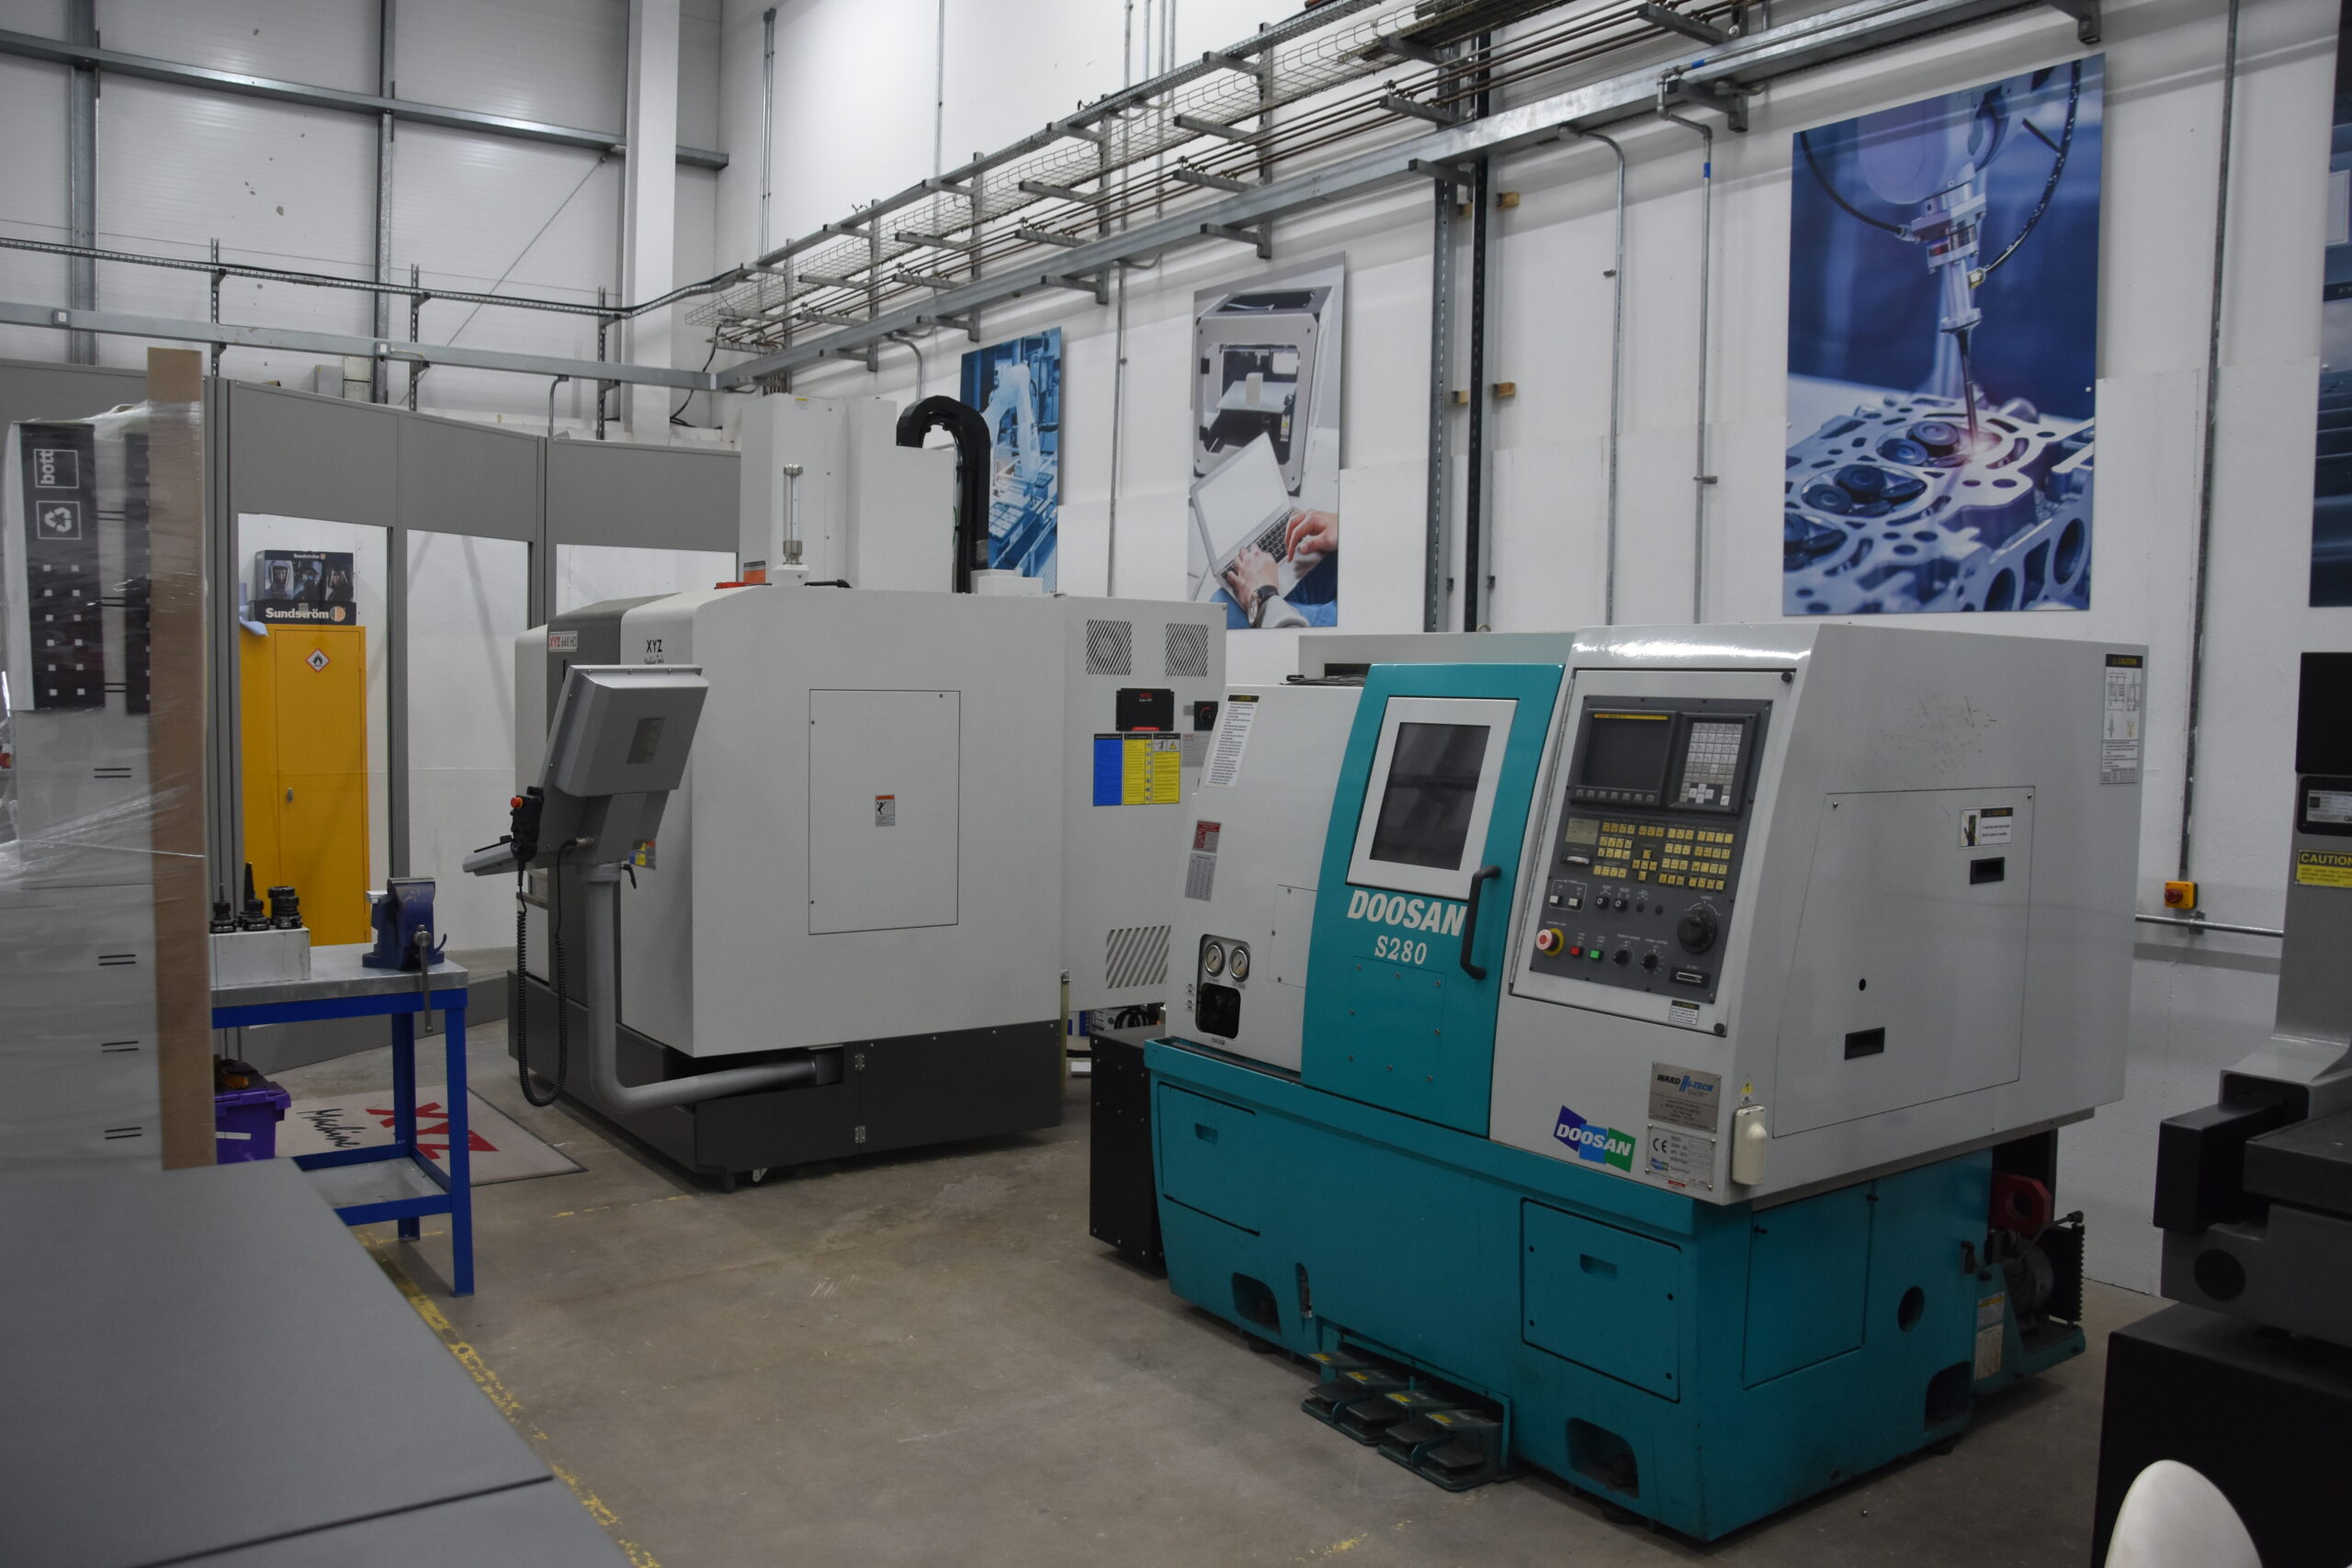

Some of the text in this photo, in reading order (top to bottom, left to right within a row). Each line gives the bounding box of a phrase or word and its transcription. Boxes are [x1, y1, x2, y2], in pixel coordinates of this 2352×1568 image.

[550, 637, 560, 647] XYZ
[647, 639, 662, 652] XYZ
[1347, 889, 1467, 937] DOOSAN
[1374, 935, 1427, 964] S280
[1657, 1073, 1681, 1085] WARD
[1555, 1123, 1632, 1156] DOOSAN
